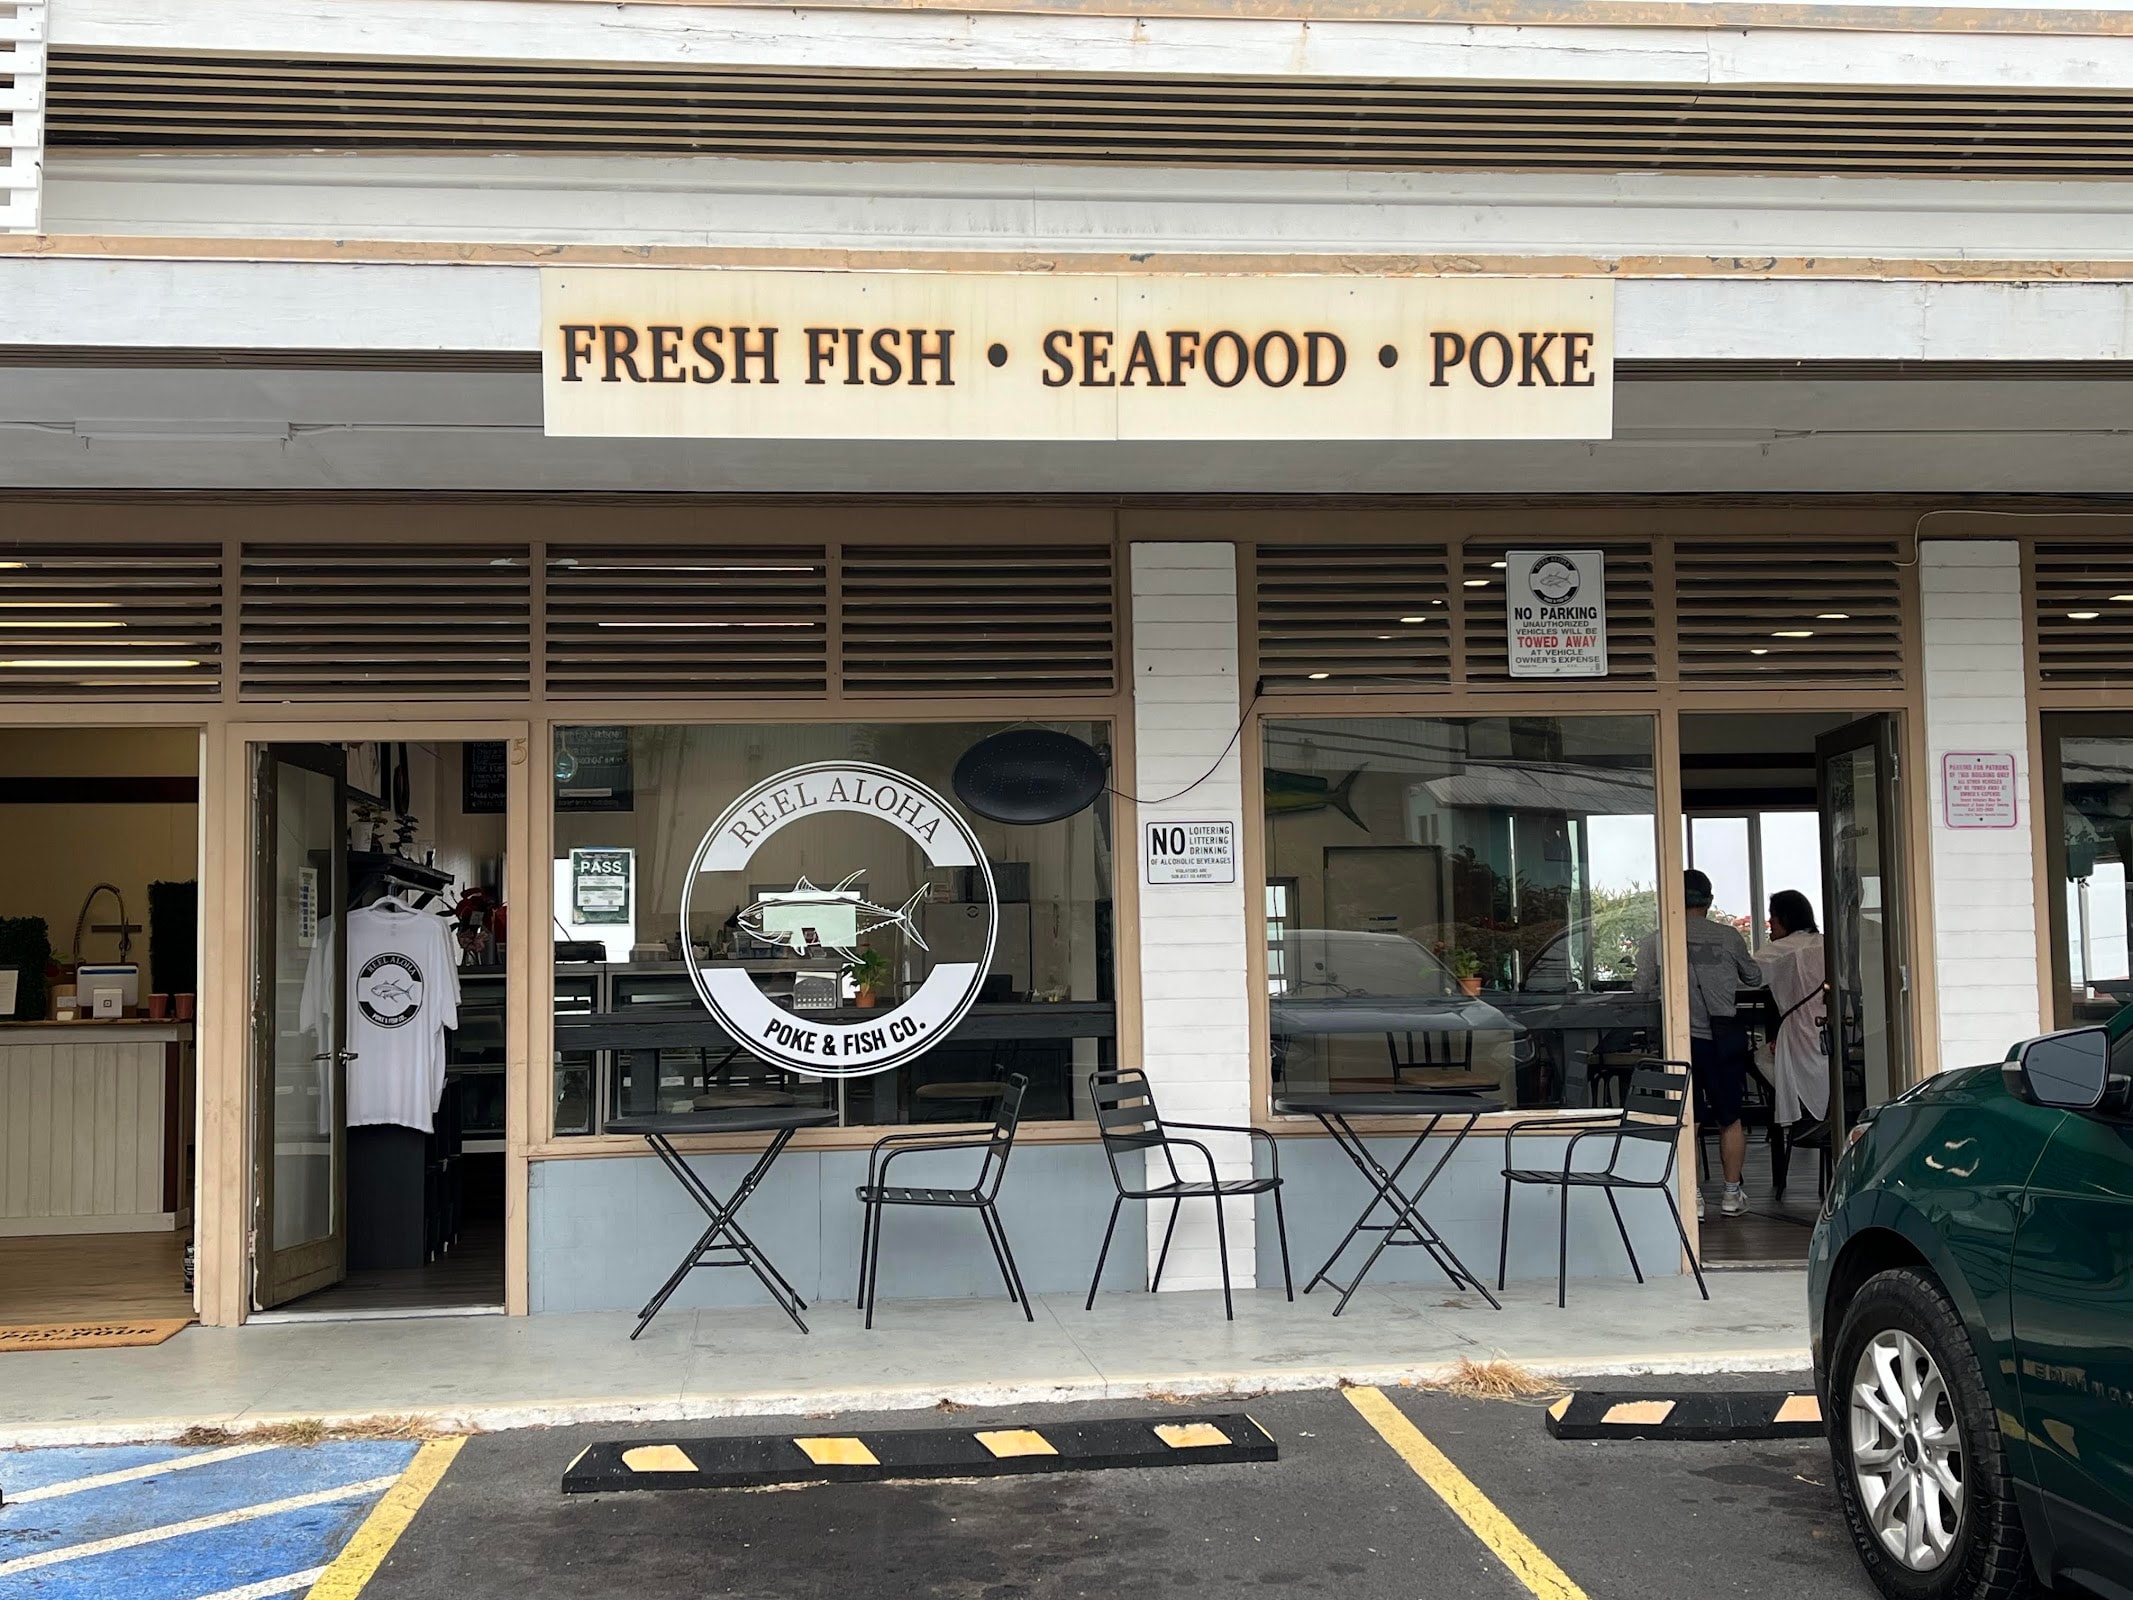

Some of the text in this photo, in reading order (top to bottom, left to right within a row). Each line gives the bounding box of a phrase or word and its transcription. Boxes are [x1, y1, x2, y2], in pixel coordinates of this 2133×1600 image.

[560, 324, 1596, 388] FRESH FISH SEAFOOD POKE
[1514, 607, 1597, 620] NO PARKING
[1585, 627, 1598, 635] BE
[1517, 635, 1597, 648] TOWED AWAY
[1515, 656, 1557, 664] OWNER'S
[728, 777, 943, 849] REEL ALOHA
[1152, 826, 1230, 855] NO LOITERING
[1189, 836, 1229, 845] LITTERING
[1190, 846, 1228, 855] DRINKING
[580, 860, 622, 873] PASS
[1196, 857, 1232, 865] BEVERAGES
[390, 957, 416, 975] ALOHA
[763, 1015, 927, 1056] POKE & FISH CO.
